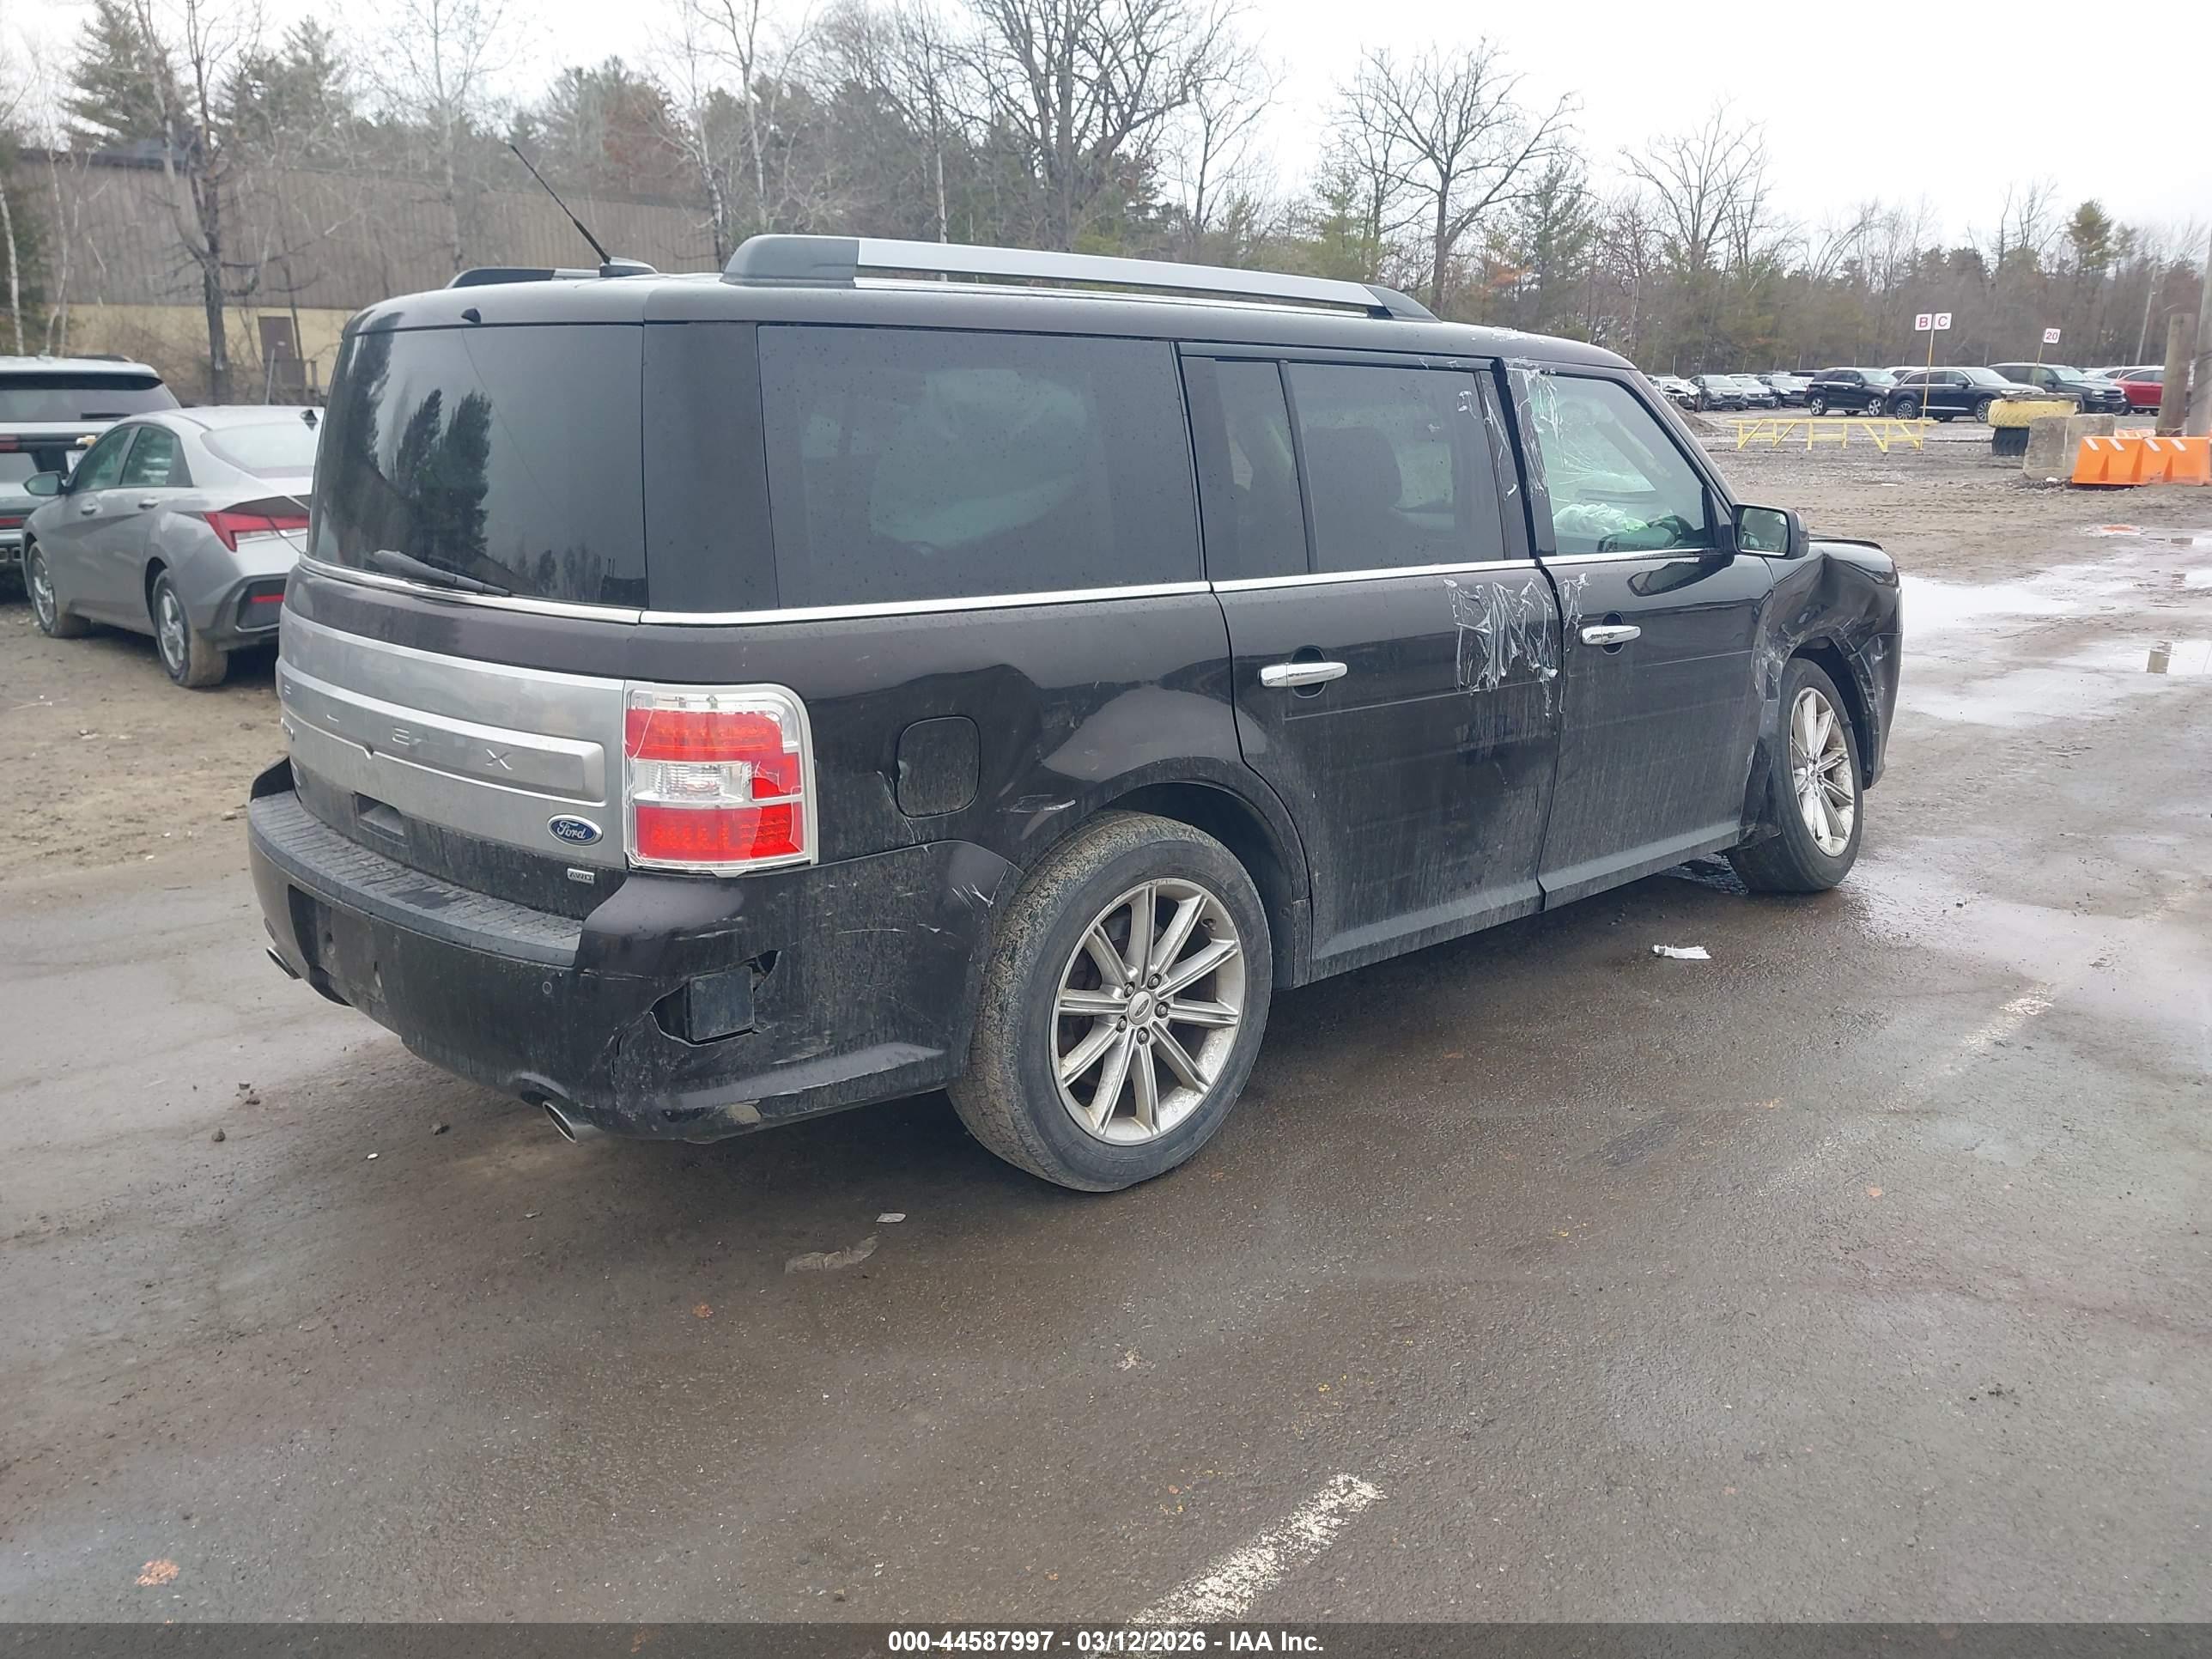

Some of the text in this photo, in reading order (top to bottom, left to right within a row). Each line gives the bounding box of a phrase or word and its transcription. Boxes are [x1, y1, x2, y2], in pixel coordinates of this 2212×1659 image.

[1919, 316, 1929, 328] B
[1937, 315, 1948, 327] C
[2045, 331, 2058, 340] 20
[556, 820, 587, 840] Ford
